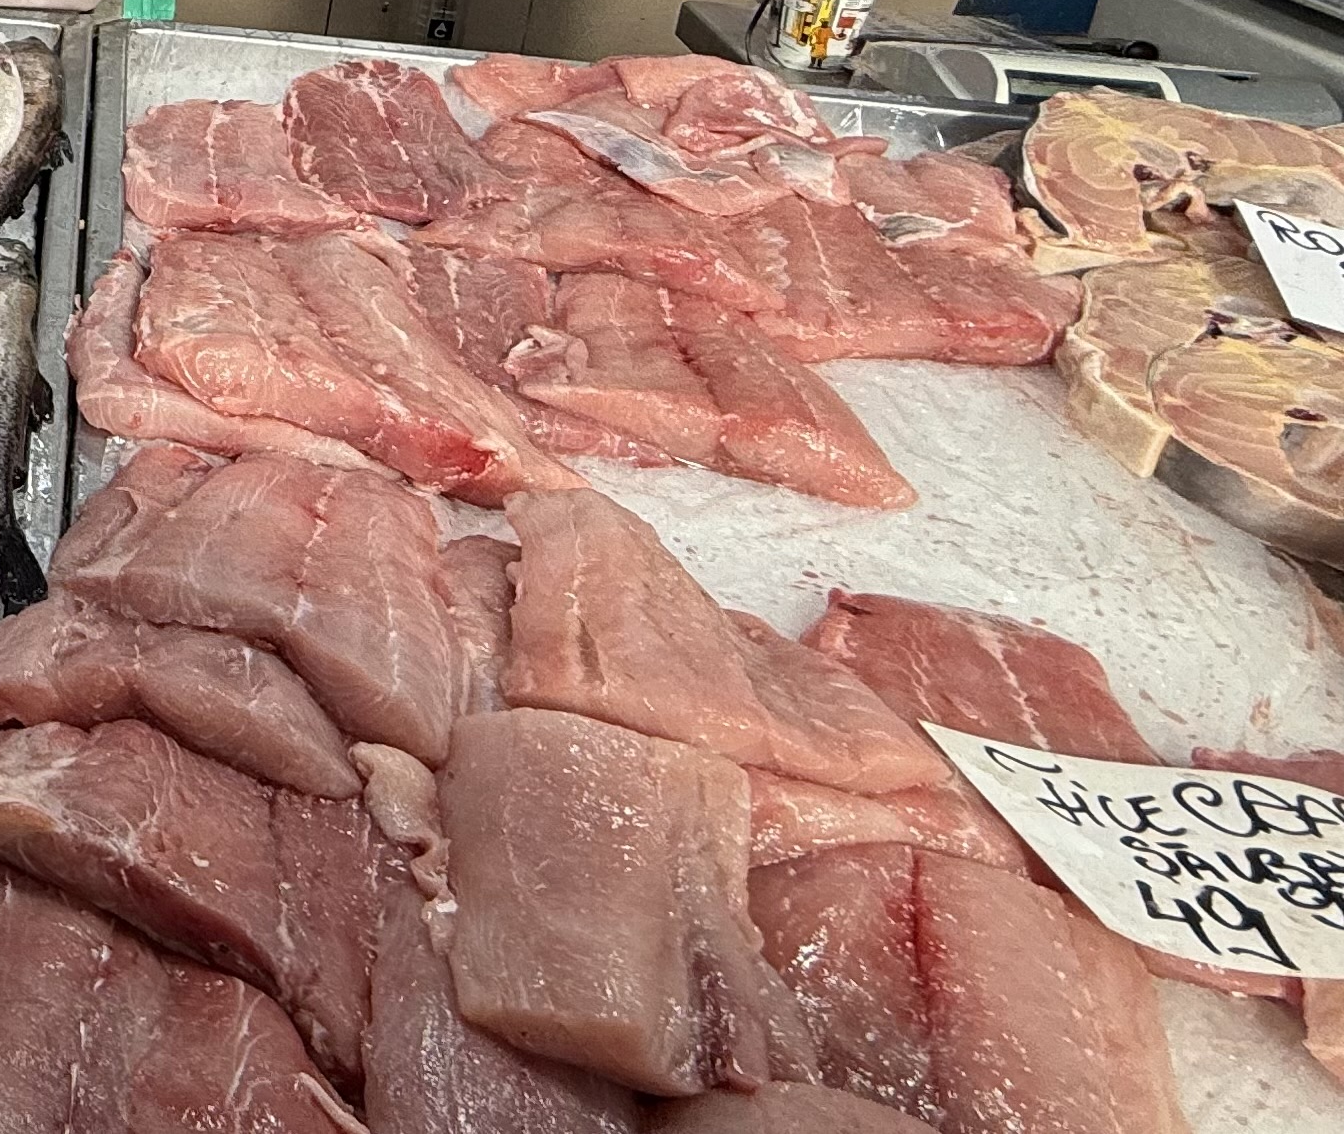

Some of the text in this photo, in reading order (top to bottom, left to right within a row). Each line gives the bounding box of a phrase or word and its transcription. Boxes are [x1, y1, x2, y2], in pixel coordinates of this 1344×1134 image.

[1256, 210, 1344, 256] RO
[1172, 779, 1344, 839] CRA
[1119, 833, 1344, 888] SĂLBA
[1135, 878, 1301, 971] 49
